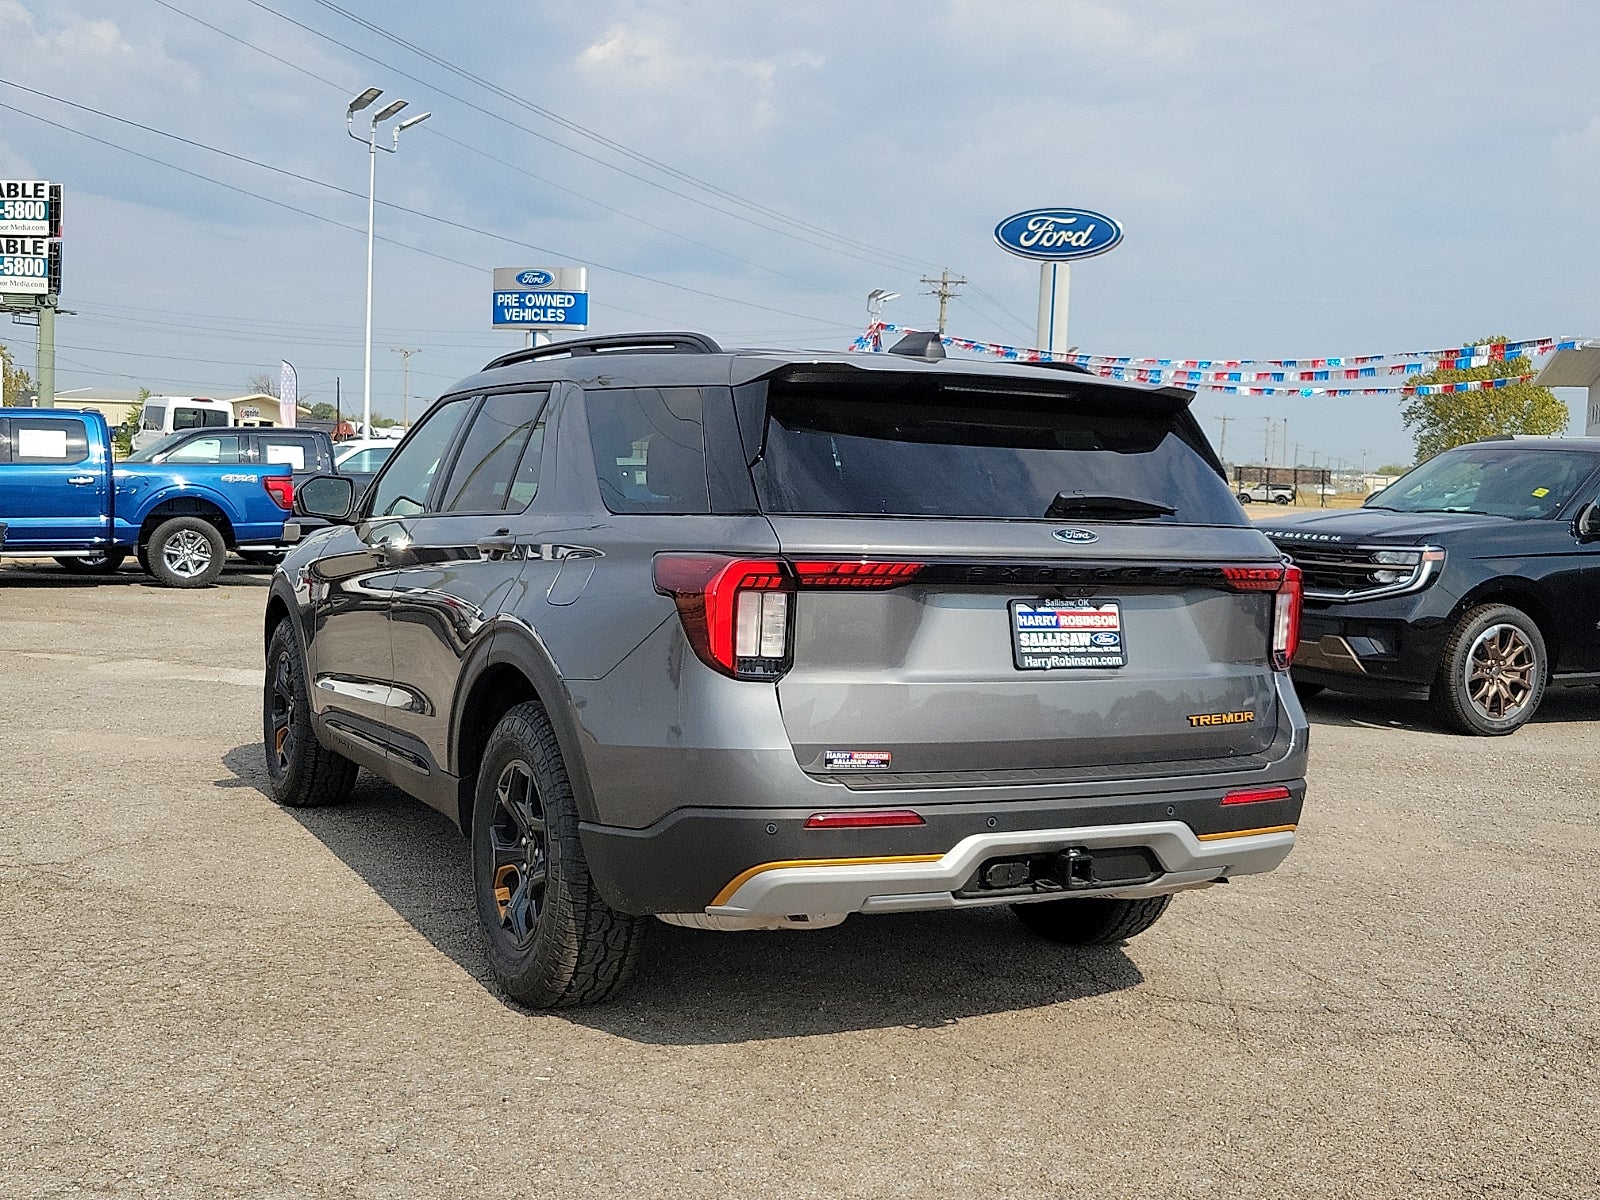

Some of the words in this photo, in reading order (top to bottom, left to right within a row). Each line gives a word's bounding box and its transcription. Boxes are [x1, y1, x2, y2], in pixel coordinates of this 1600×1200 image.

[10, 223, 46, 231] Media.com
[1019, 216, 1095, 247] Ford
[9, 279, 45, 288] Media.com
[522, 272, 545, 284] Ford
[497, 294, 575, 308] PRE-OWNED
[504, 308, 566, 321] VEHICLES
[1064, 529, 1090, 539] Ford
[1045, 599, 1076, 607] Sallisaw,
[1077, 599, 1090, 607] OK
[1019, 615, 1058, 627] HARRY
[1060, 615, 1118, 627] ROBINSON
[1020, 633, 1091, 646] SALLISAW
[1024, 656, 1123, 669] HarryRobinson.com
[1188, 711, 1255, 727] TREMOR
